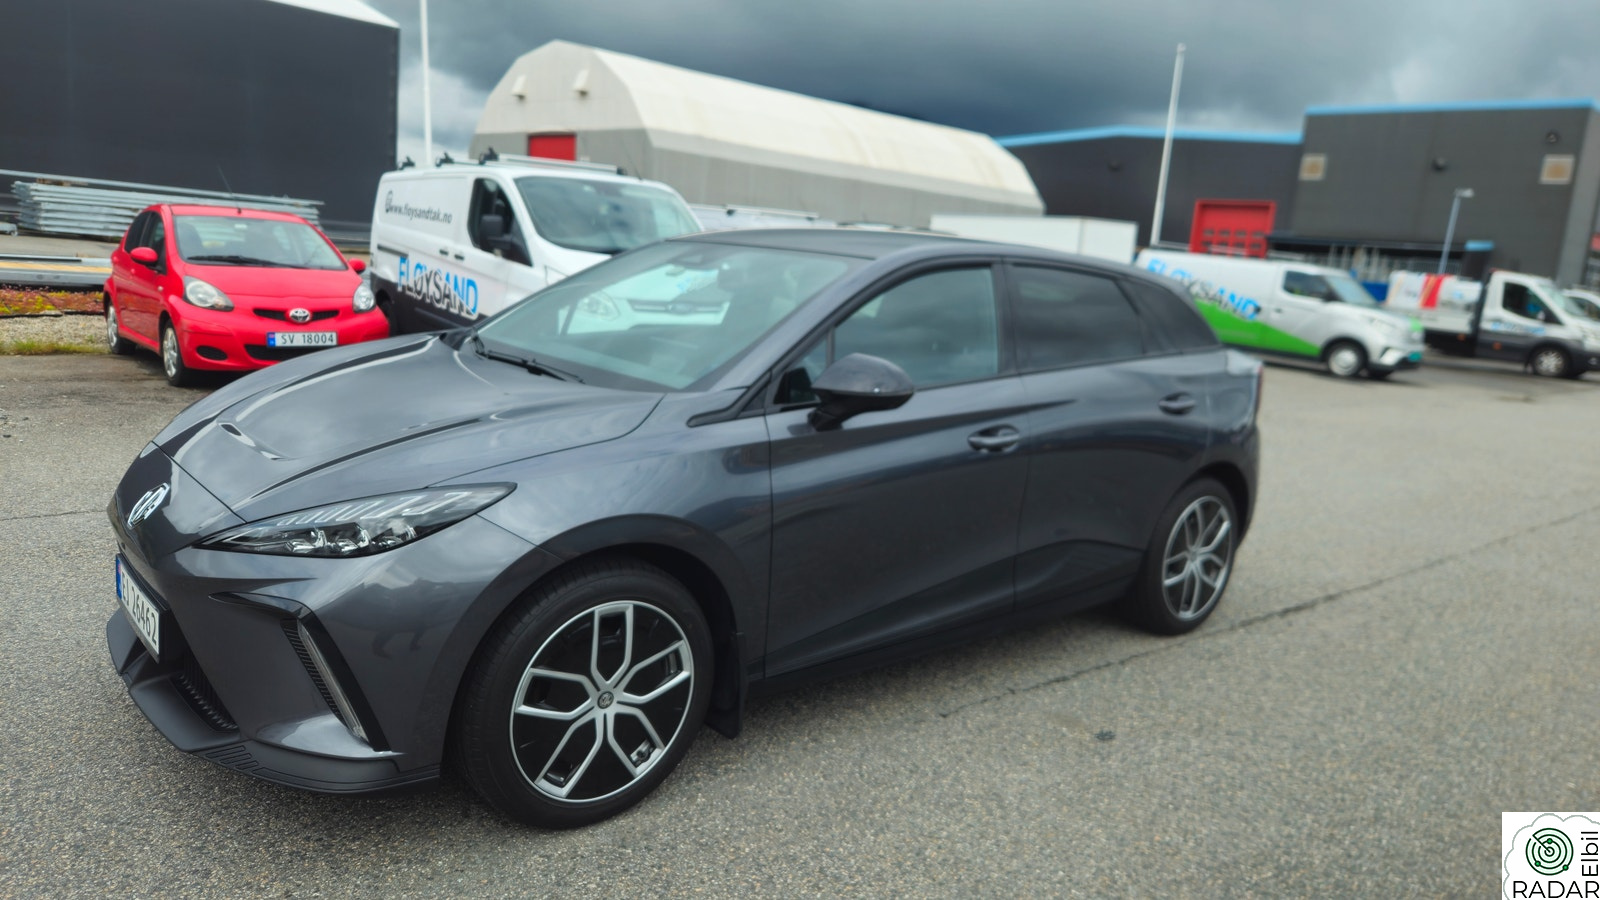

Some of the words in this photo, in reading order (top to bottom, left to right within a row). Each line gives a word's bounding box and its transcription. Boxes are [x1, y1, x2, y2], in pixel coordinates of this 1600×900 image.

[281, 334, 295, 345] SV
[302, 333, 334, 344] 18004
[131, 585, 157, 646] 26462
